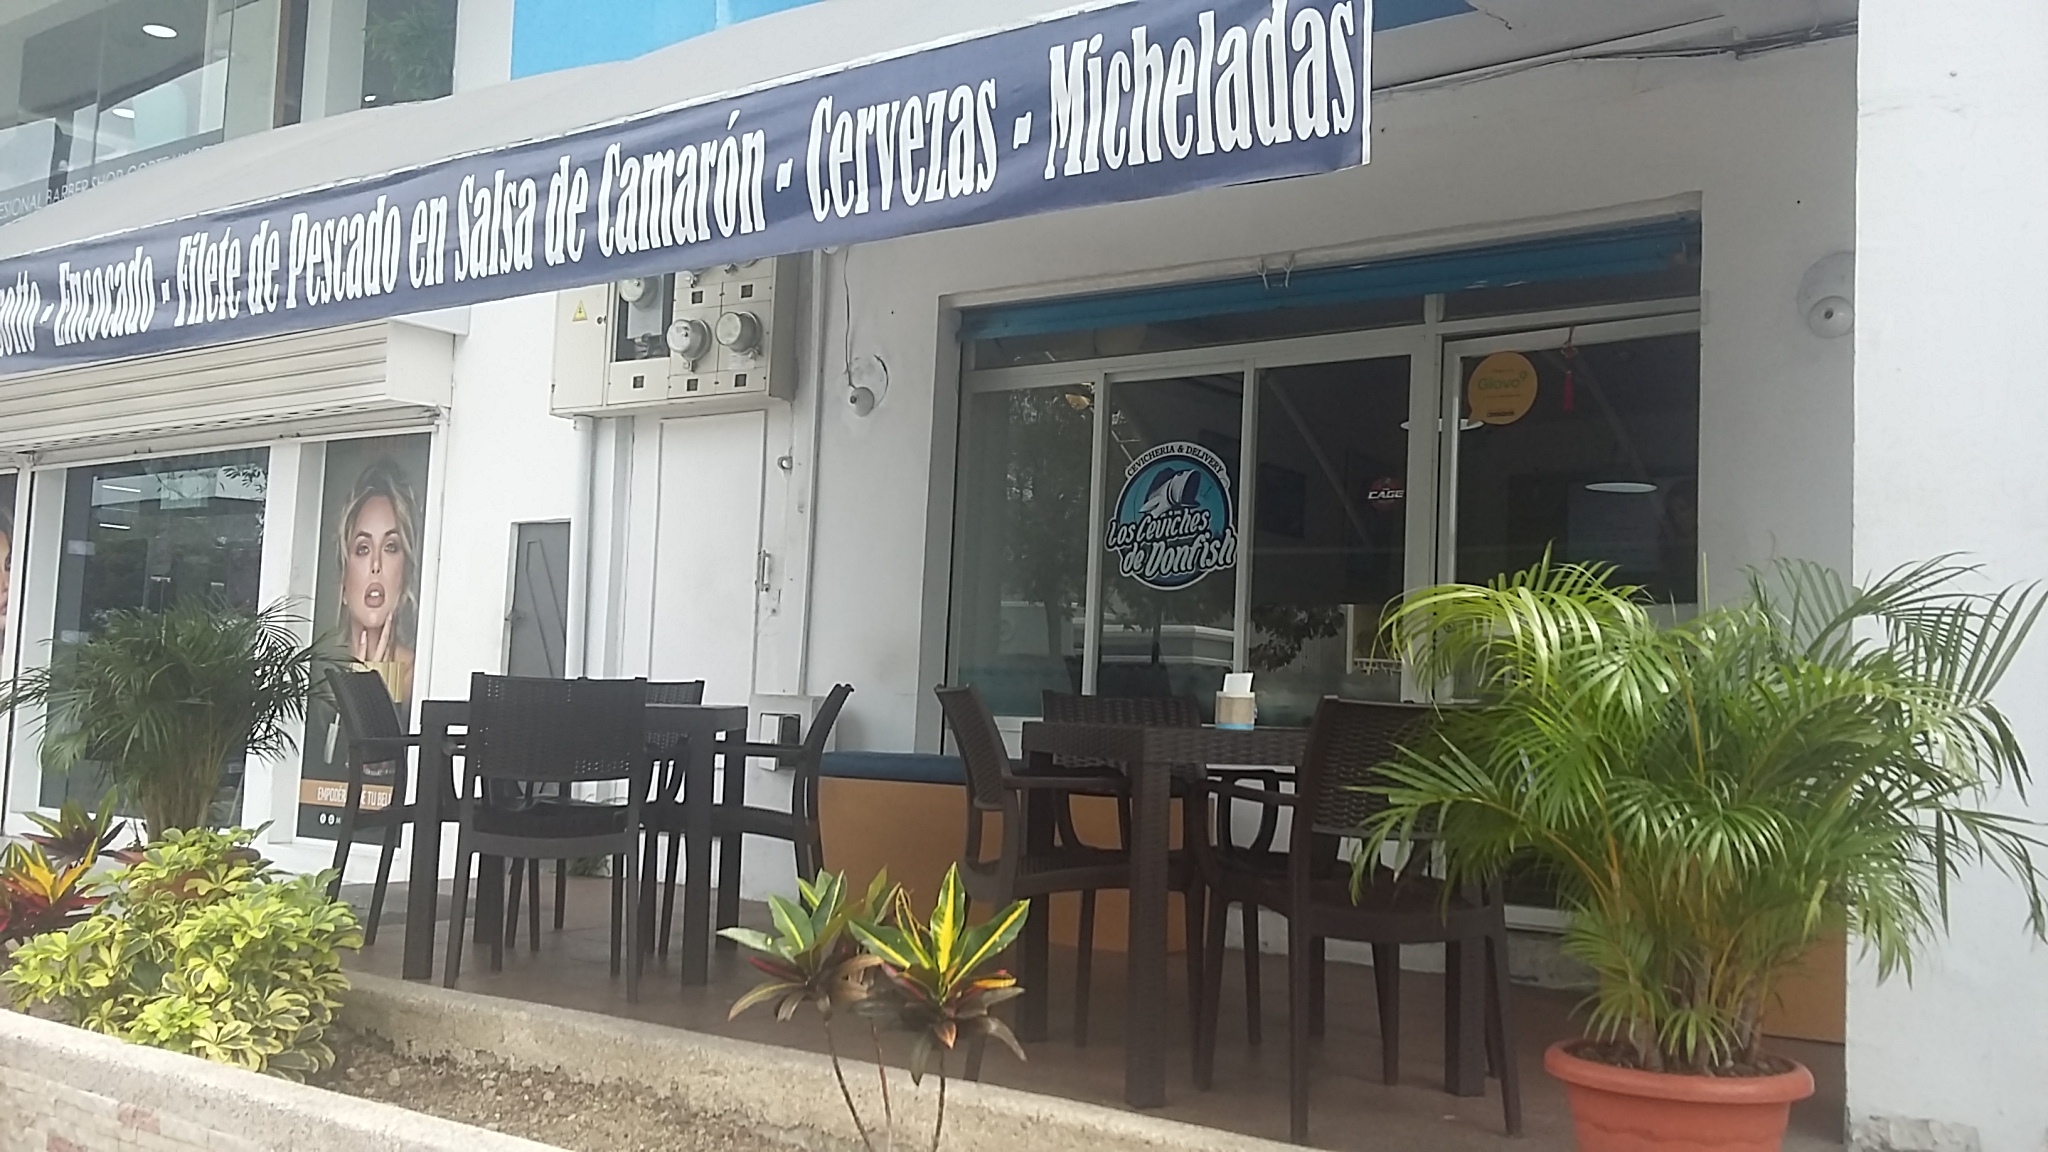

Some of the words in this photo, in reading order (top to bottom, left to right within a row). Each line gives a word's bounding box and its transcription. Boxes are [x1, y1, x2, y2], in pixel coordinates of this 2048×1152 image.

[54, 246, 155, 346] Encocado
[174, 227, 241, 327] Filete
[248, 220, 280, 315] de
[286, 195, 401, 309] Pescado
[409, 195, 448, 289] en
[455, 169, 537, 282] Salsa
[545, 155, 589, 266] de
[598, 109, 766, 257] Camarón
[806, 78, 998, 222] Cervezas
[1044, 0, 1355, 179] Micheladas
[1127, 444, 1175, 477] CEVICHERIA
[1185, 445, 1224, 474] DELIVERY
[1368, 490, 1405, 500] CAGE
[1108, 521, 1136, 546] Los
[1138, 509, 1209, 541] Ceviches
[1123, 542, 1144, 572] de
[1146, 529, 1235, 576] Donfish
